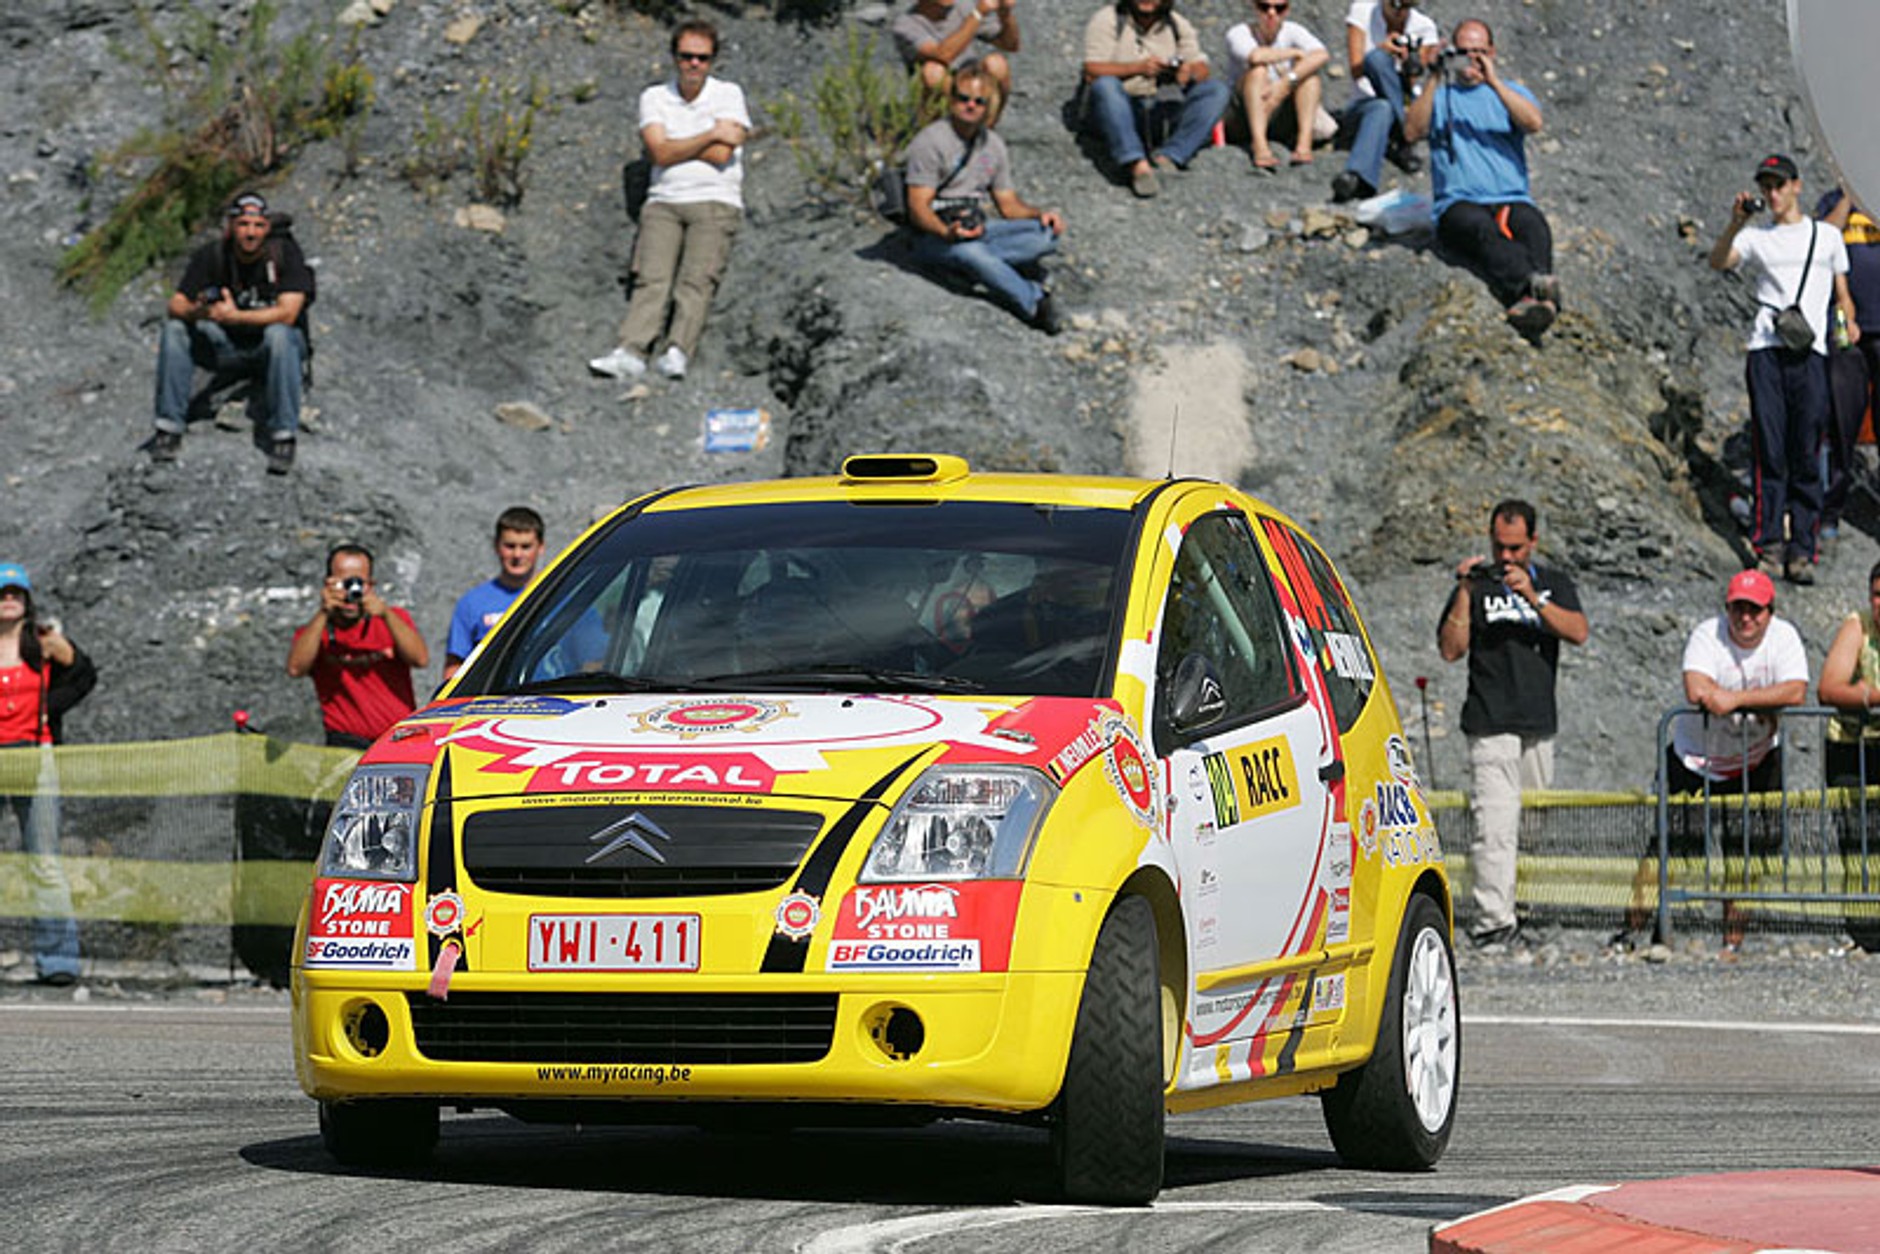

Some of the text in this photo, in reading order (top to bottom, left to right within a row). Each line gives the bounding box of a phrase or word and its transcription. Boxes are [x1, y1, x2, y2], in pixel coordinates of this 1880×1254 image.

[553, 760, 763, 785] TOTAL
[1241, 746, 1289, 808] RACC
[1376, 782, 1419, 826] RACB
[327, 920, 391, 935] STONE
[867, 924, 949, 938] STONE
[834, 944, 973, 962] BFGoodrich
[537, 1066, 692, 1085] www.myracing.be
